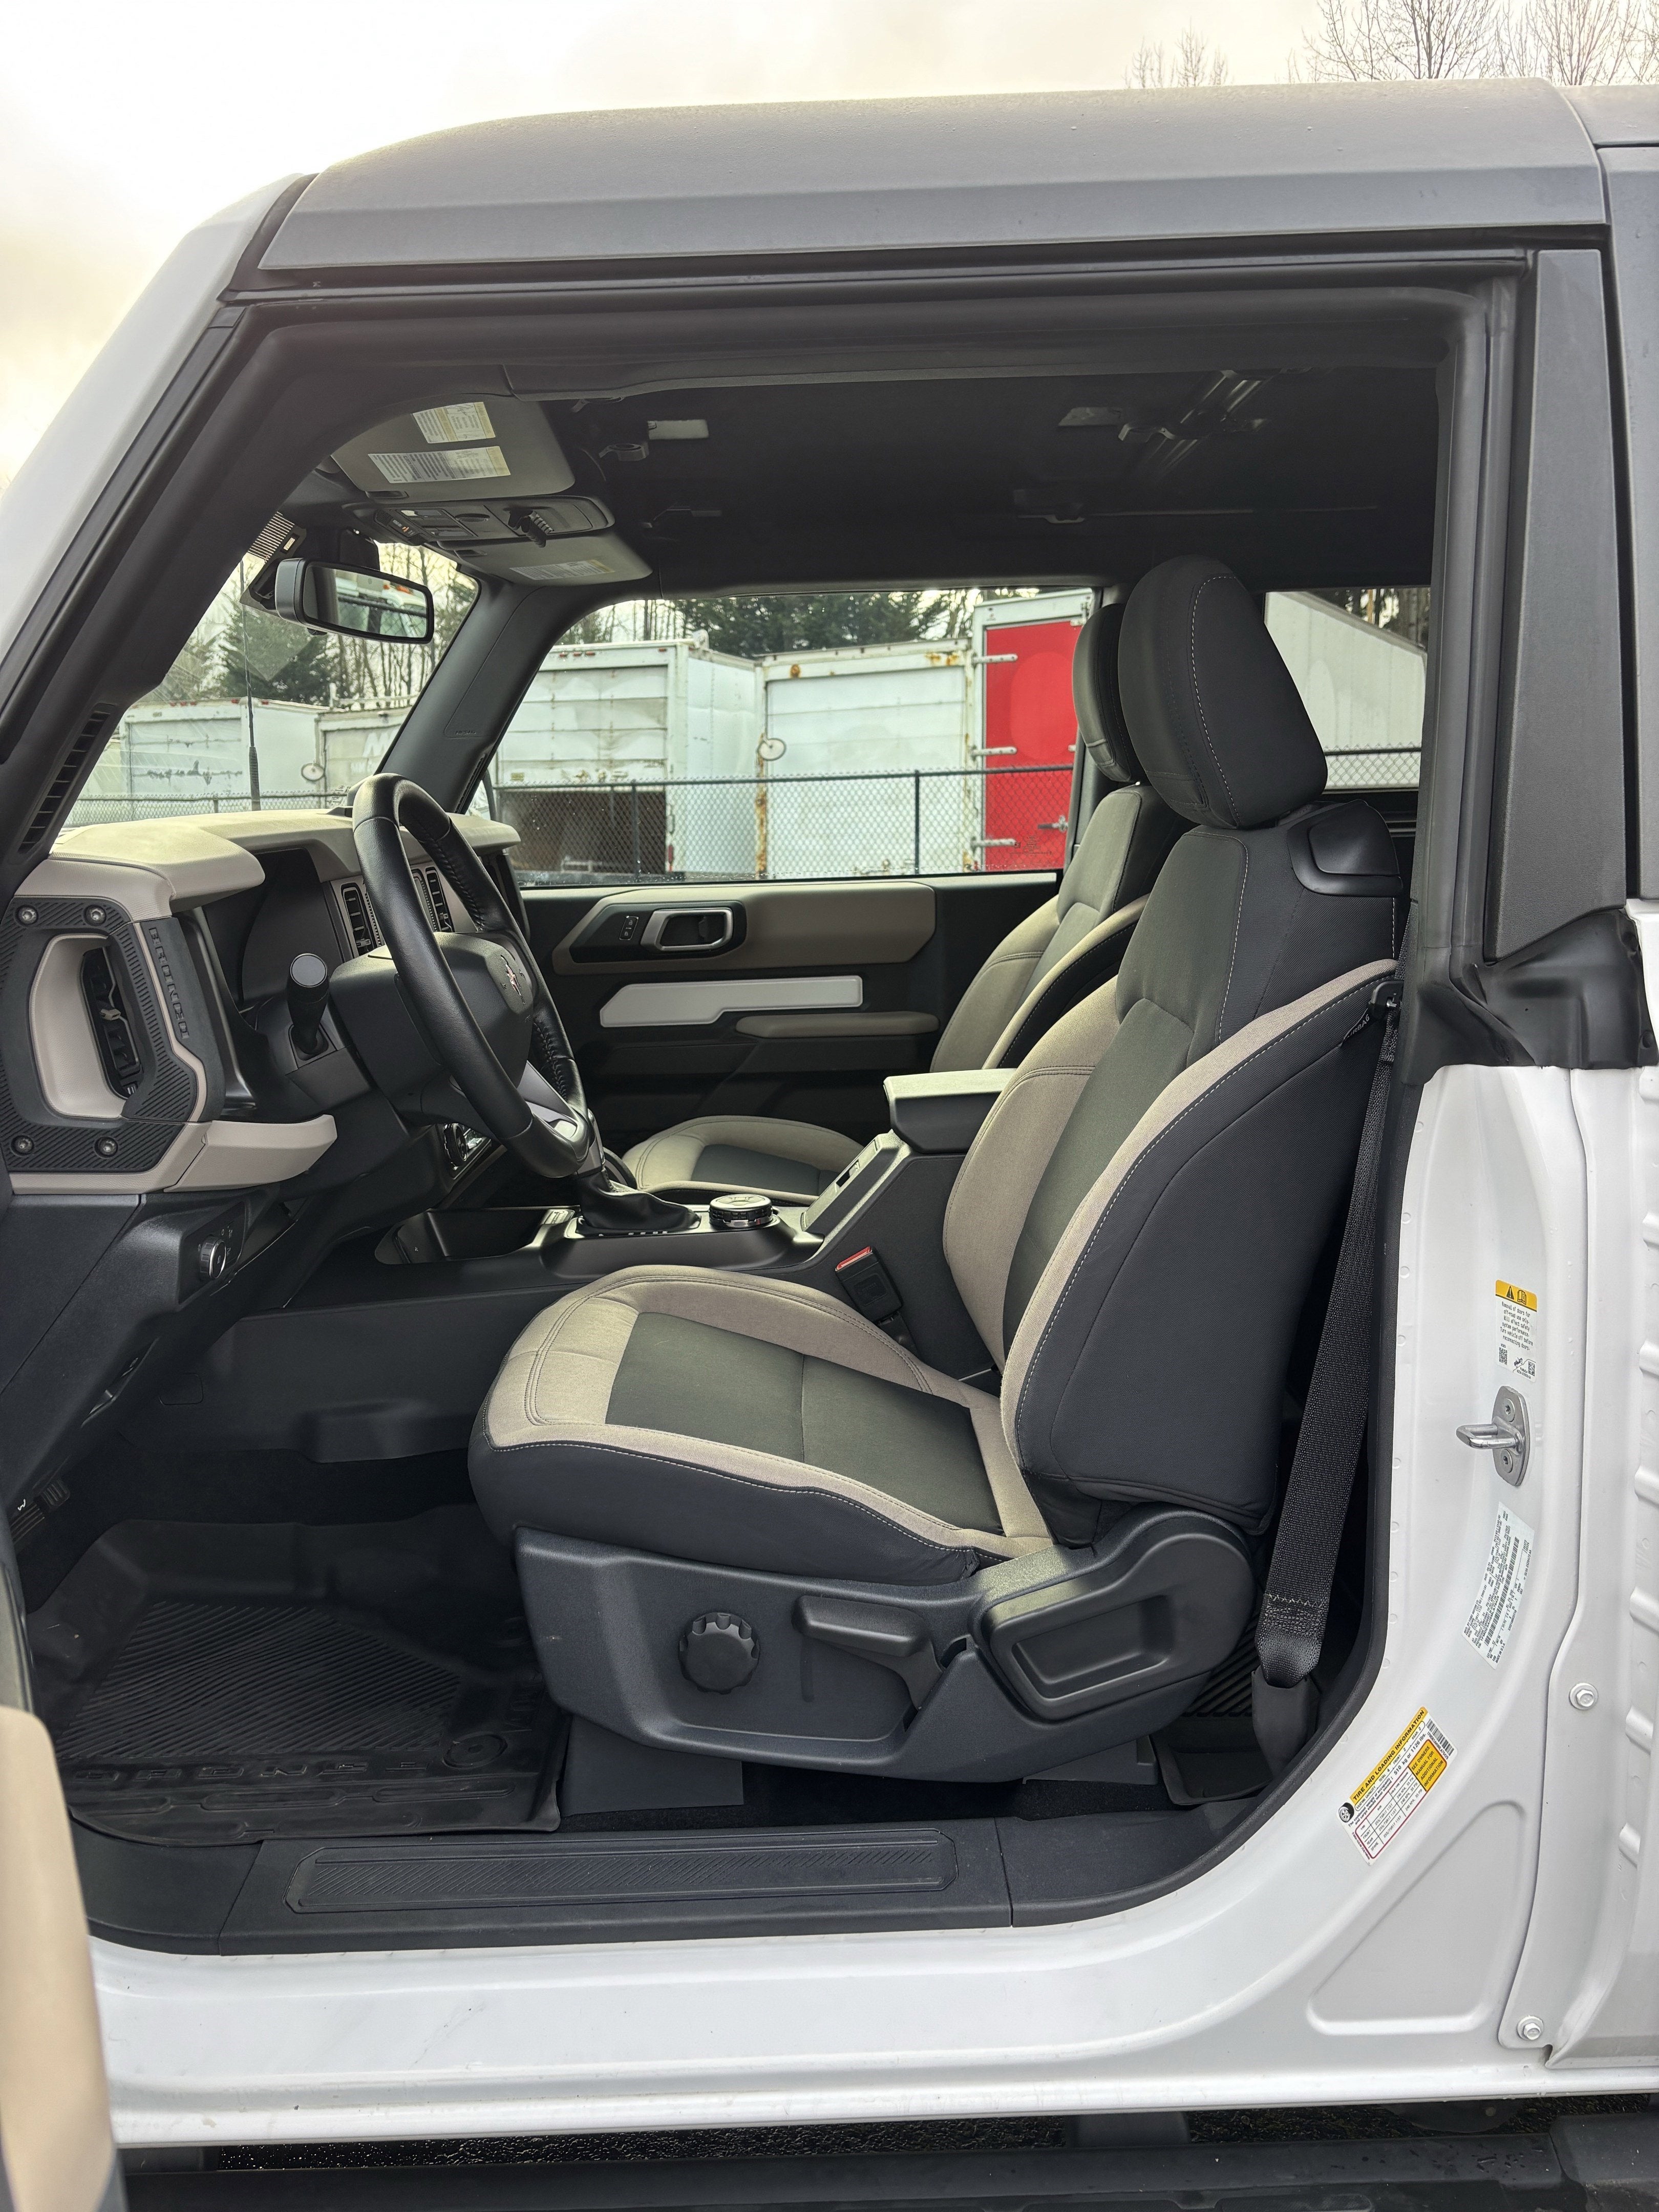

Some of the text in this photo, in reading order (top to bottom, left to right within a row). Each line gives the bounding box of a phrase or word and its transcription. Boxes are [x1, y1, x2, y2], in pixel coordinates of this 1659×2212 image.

[148, 927, 190, 1039] BRONCO
[1352, 1709, 1424, 1802] TIRE AND LOADING INFORMATION
[1415, 1758, 1429, 1776] MANUAL
[1417, 1745, 1430, 1763] OWNERS
[1420, 1756, 1438, 1780] ADDITIONAL
[1367, 1799, 1376, 1811] should
[1393, 1764, 1401, 1775] 510
[1401, 1757, 1408, 1766] kg
[1411, 1739, 1420, 1753] 1126
[1423, 1759, 1443, 1788] INFORMATION
[1353, 1805, 1366, 1822] combined
[1365, 1795, 1375, 1807] weight
